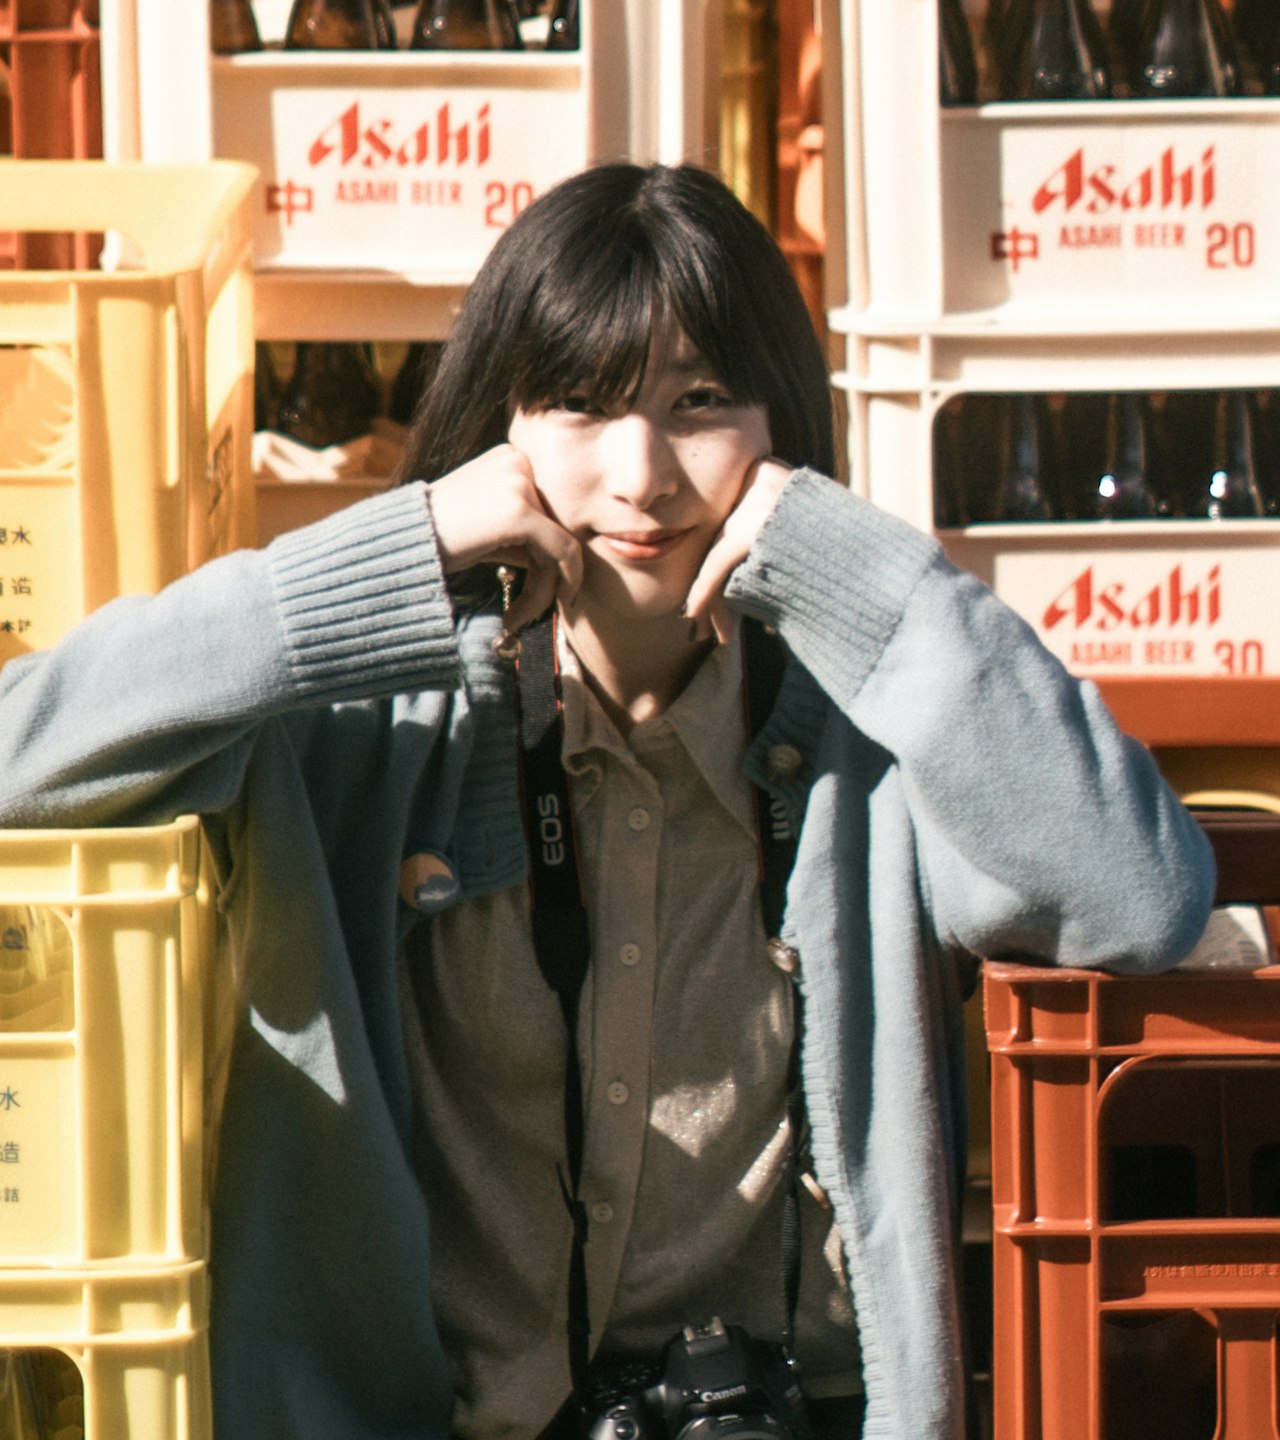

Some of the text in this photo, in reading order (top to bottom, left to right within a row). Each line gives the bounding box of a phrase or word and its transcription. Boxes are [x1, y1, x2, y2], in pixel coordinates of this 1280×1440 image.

[308, 100, 490, 167] Asahi
[266, 180, 313, 227] 中
[335, 181, 398, 203] ASAHI
[412, 181, 462, 203] BEER
[1031, 144, 1215, 213] Asahi
[990, 222, 1254, 273] 中 ASAHI BEER 20
[1042, 563, 1221, 631] Asahi
[1071, 640, 1131, 665] ASAHI
[1144, 640, 1195, 665] BEER
[538, 793, 565, 866] EOS
[701, 1385, 746, 1402] Canon
